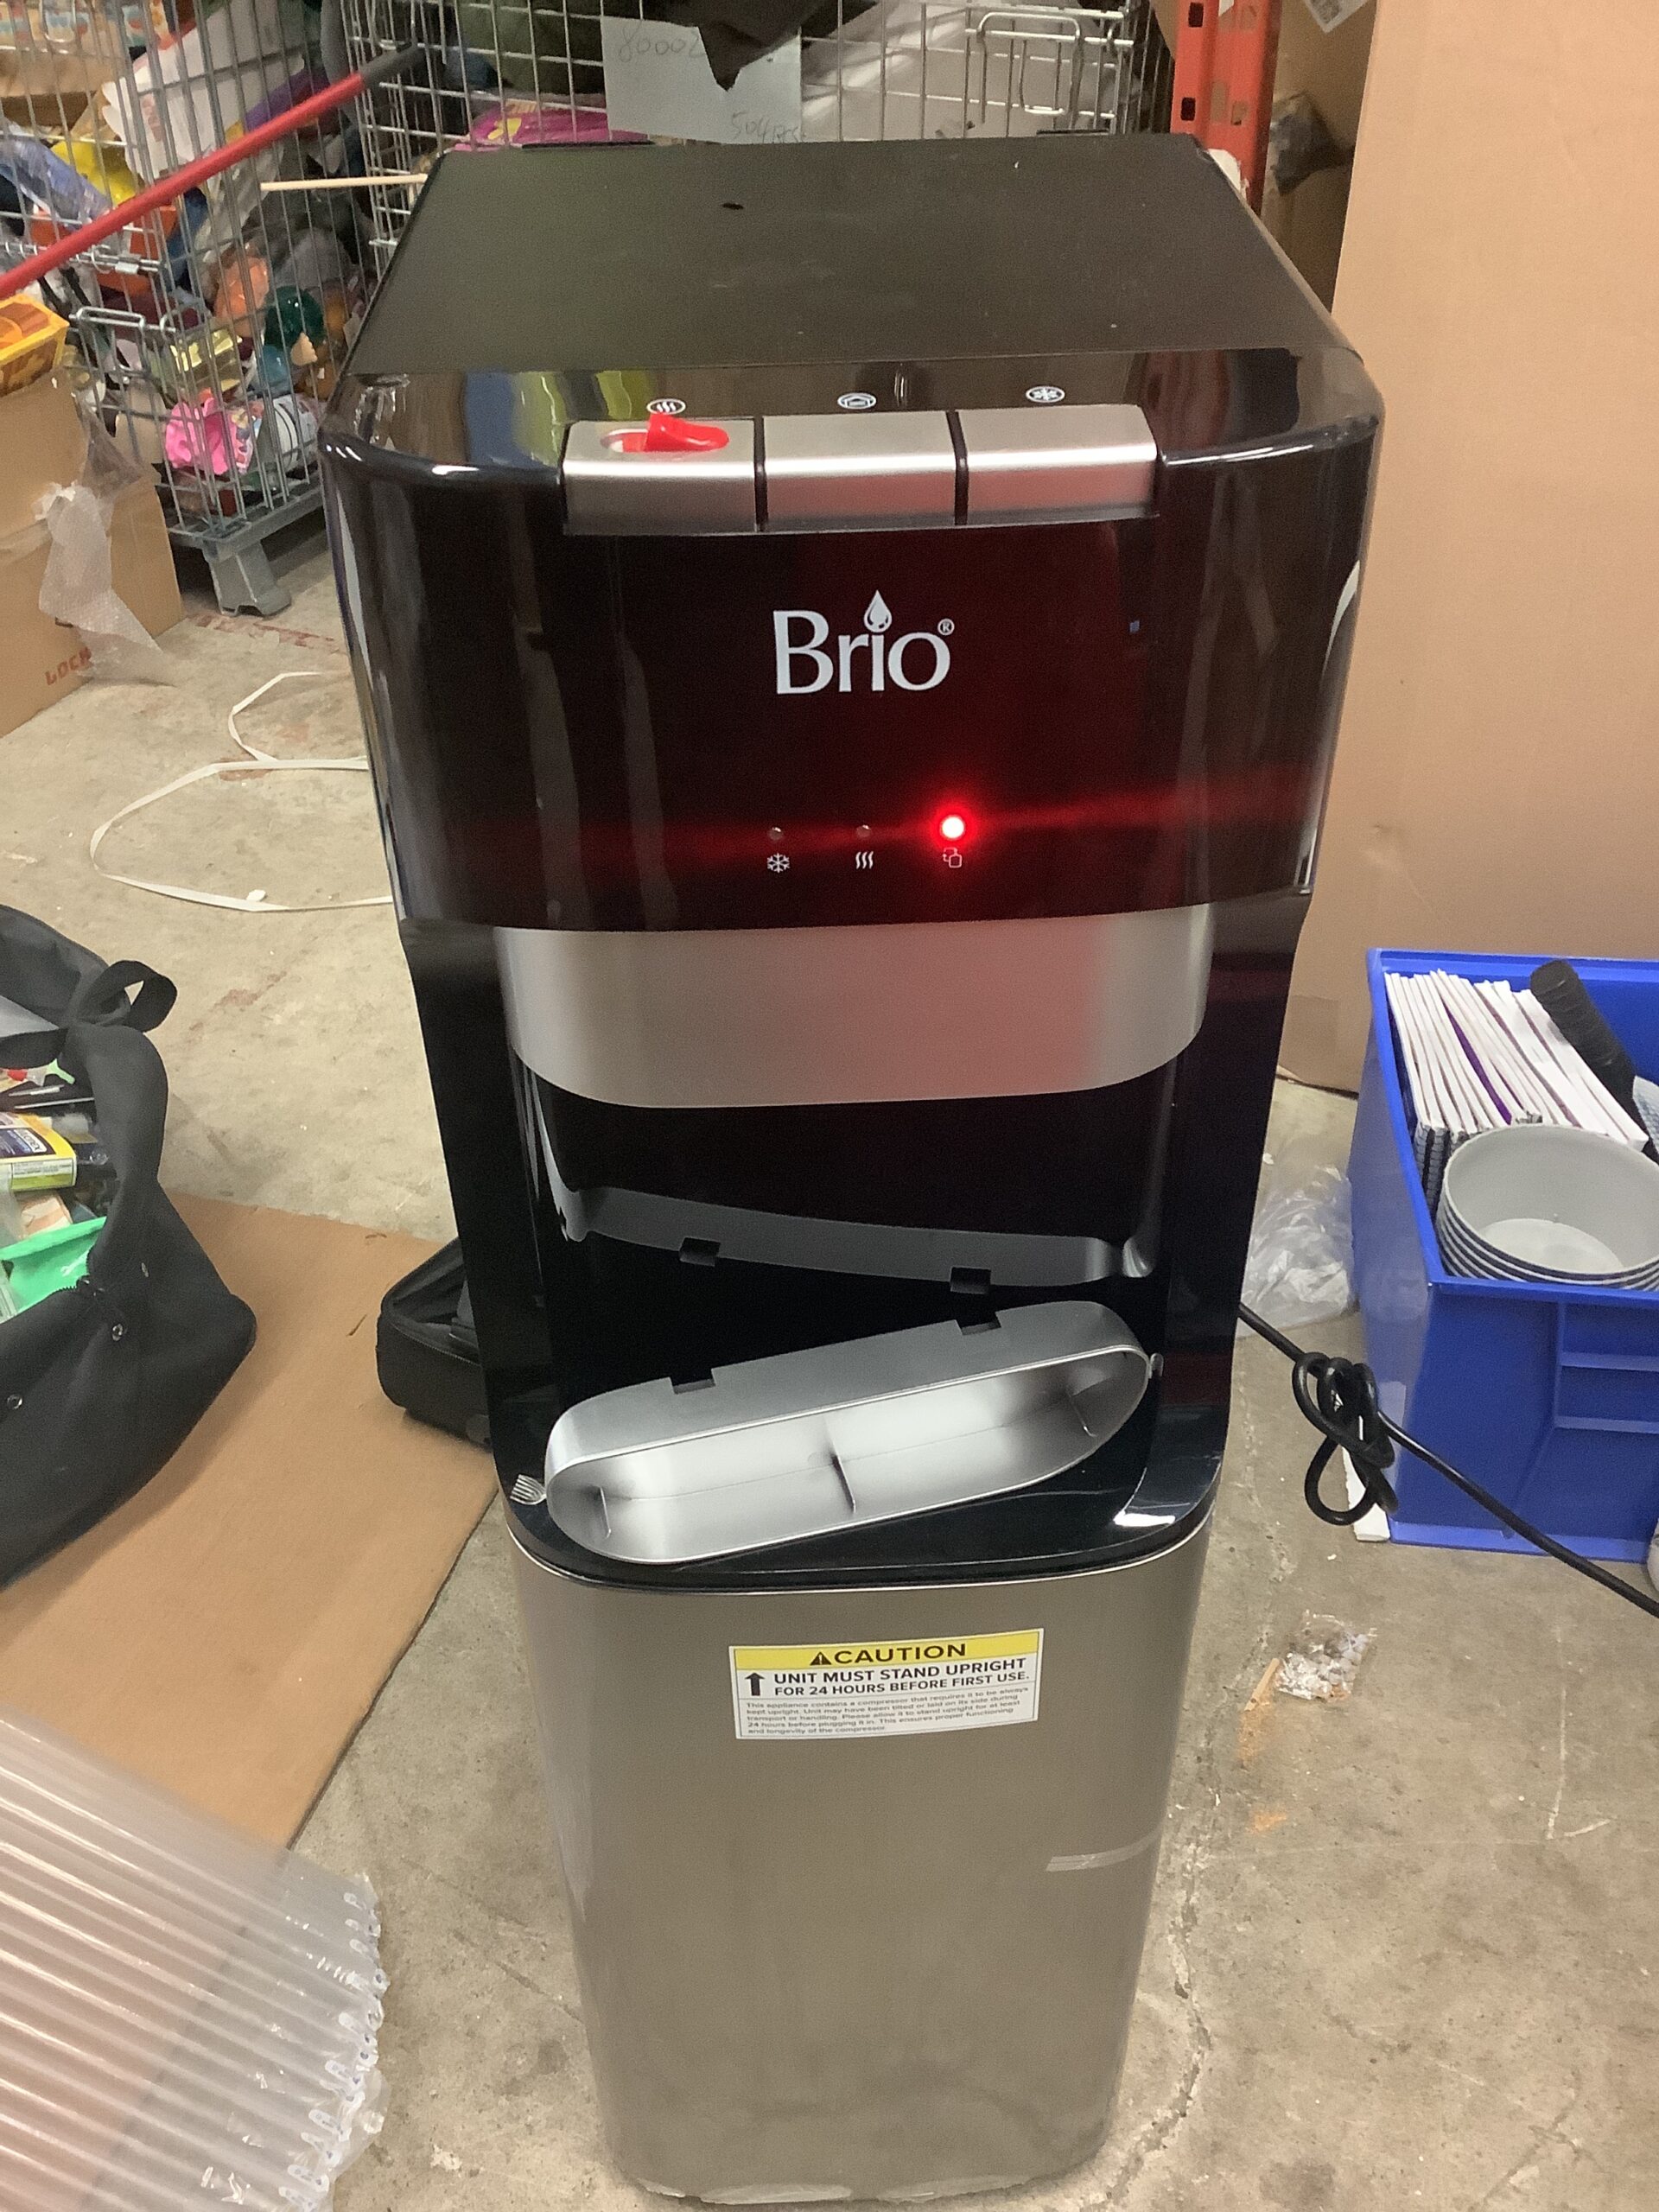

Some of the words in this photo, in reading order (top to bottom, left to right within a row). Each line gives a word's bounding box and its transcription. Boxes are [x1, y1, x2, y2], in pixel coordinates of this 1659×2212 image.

[834, 1643, 966, 1664] CAUTION
[774, 1672, 817, 1684] UNIT
[823, 1670, 874, 1683] MUST
[880, 1666, 940, 1680] STAND
[946, 1658, 1027, 1675] UPRIGHT
[775, 1687, 804, 1696] FOR
[810, 1686, 827, 1695] 24
[832, 1684, 885, 1694] HOURS
[890, 1679, 948, 1692] BEFORE
[952, 1675, 993, 1687] FIRST
[997, 1671, 1030, 1682] USE.
